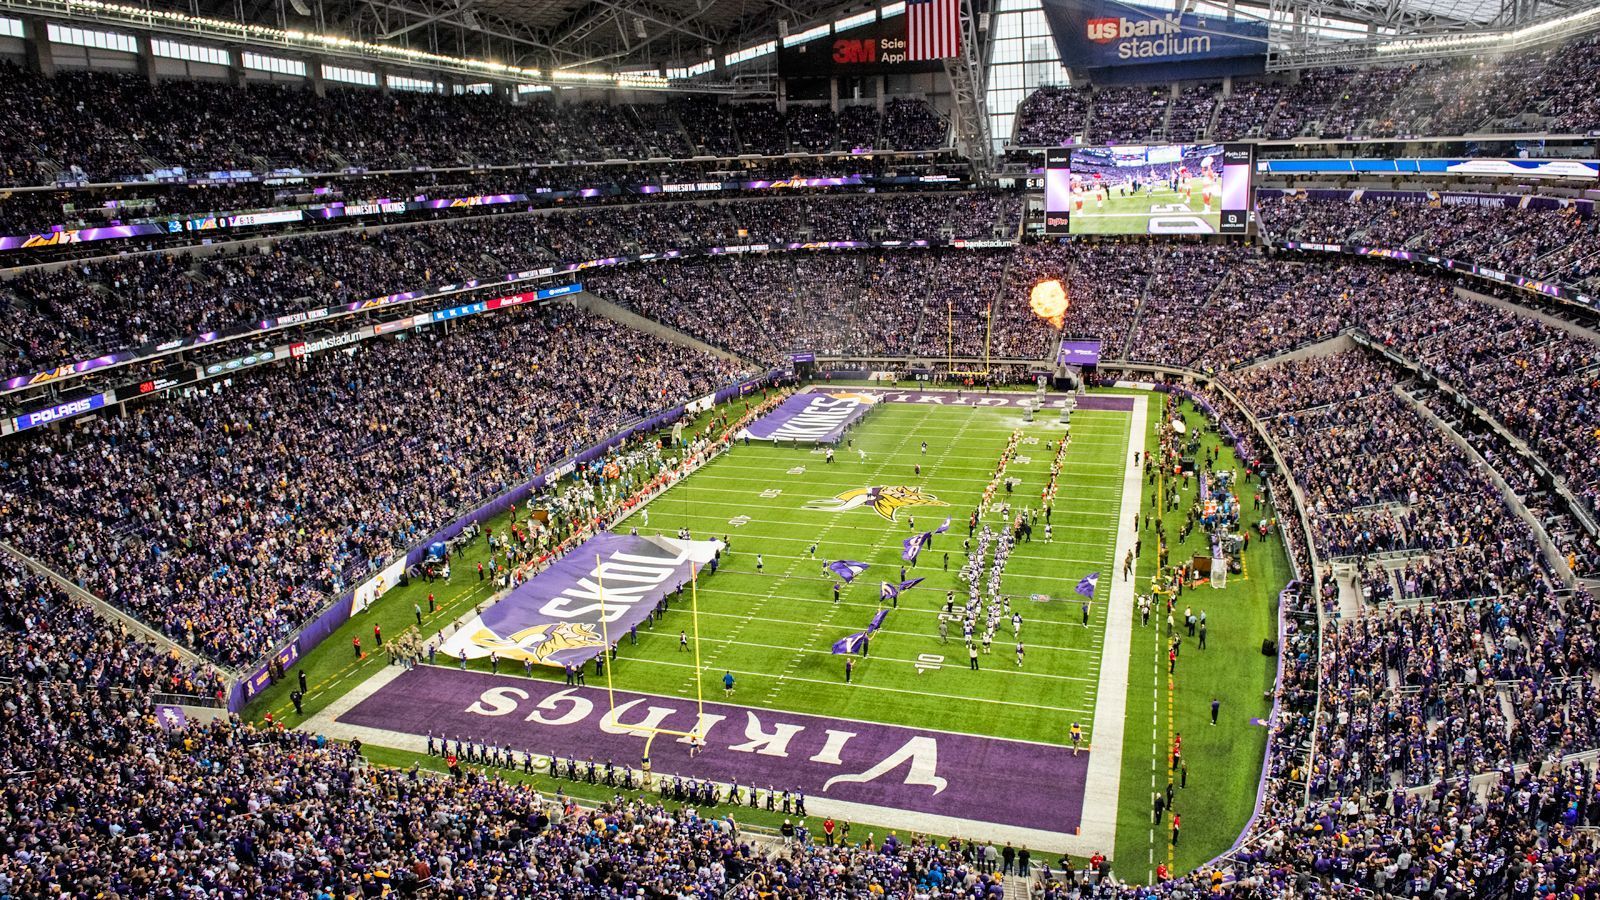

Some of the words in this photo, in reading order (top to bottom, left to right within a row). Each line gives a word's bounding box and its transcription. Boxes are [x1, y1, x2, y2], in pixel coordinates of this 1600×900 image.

[832, 39, 875, 63] 3M
[1118, 34, 1210, 58] stadium
[662, 184, 695, 192] MINNESOTA
[697, 182, 721, 191] VIKINGS
[345, 204, 380, 216] MINNESOTA
[382, 202, 405, 213] VIKINGS
[1442, 195, 1478, 205] MINNESOTA
[1480, 198, 1505, 208] VIKINGS
[277, 312, 307, 325] MINNESOTA
[307, 307, 329, 320] VIKINGS
[140, 381, 154, 393] 3M
[30, 398, 92, 426] POLARIS
[538, 548, 690, 623] SKOL
[464, 686, 948, 796] VIKINGS
